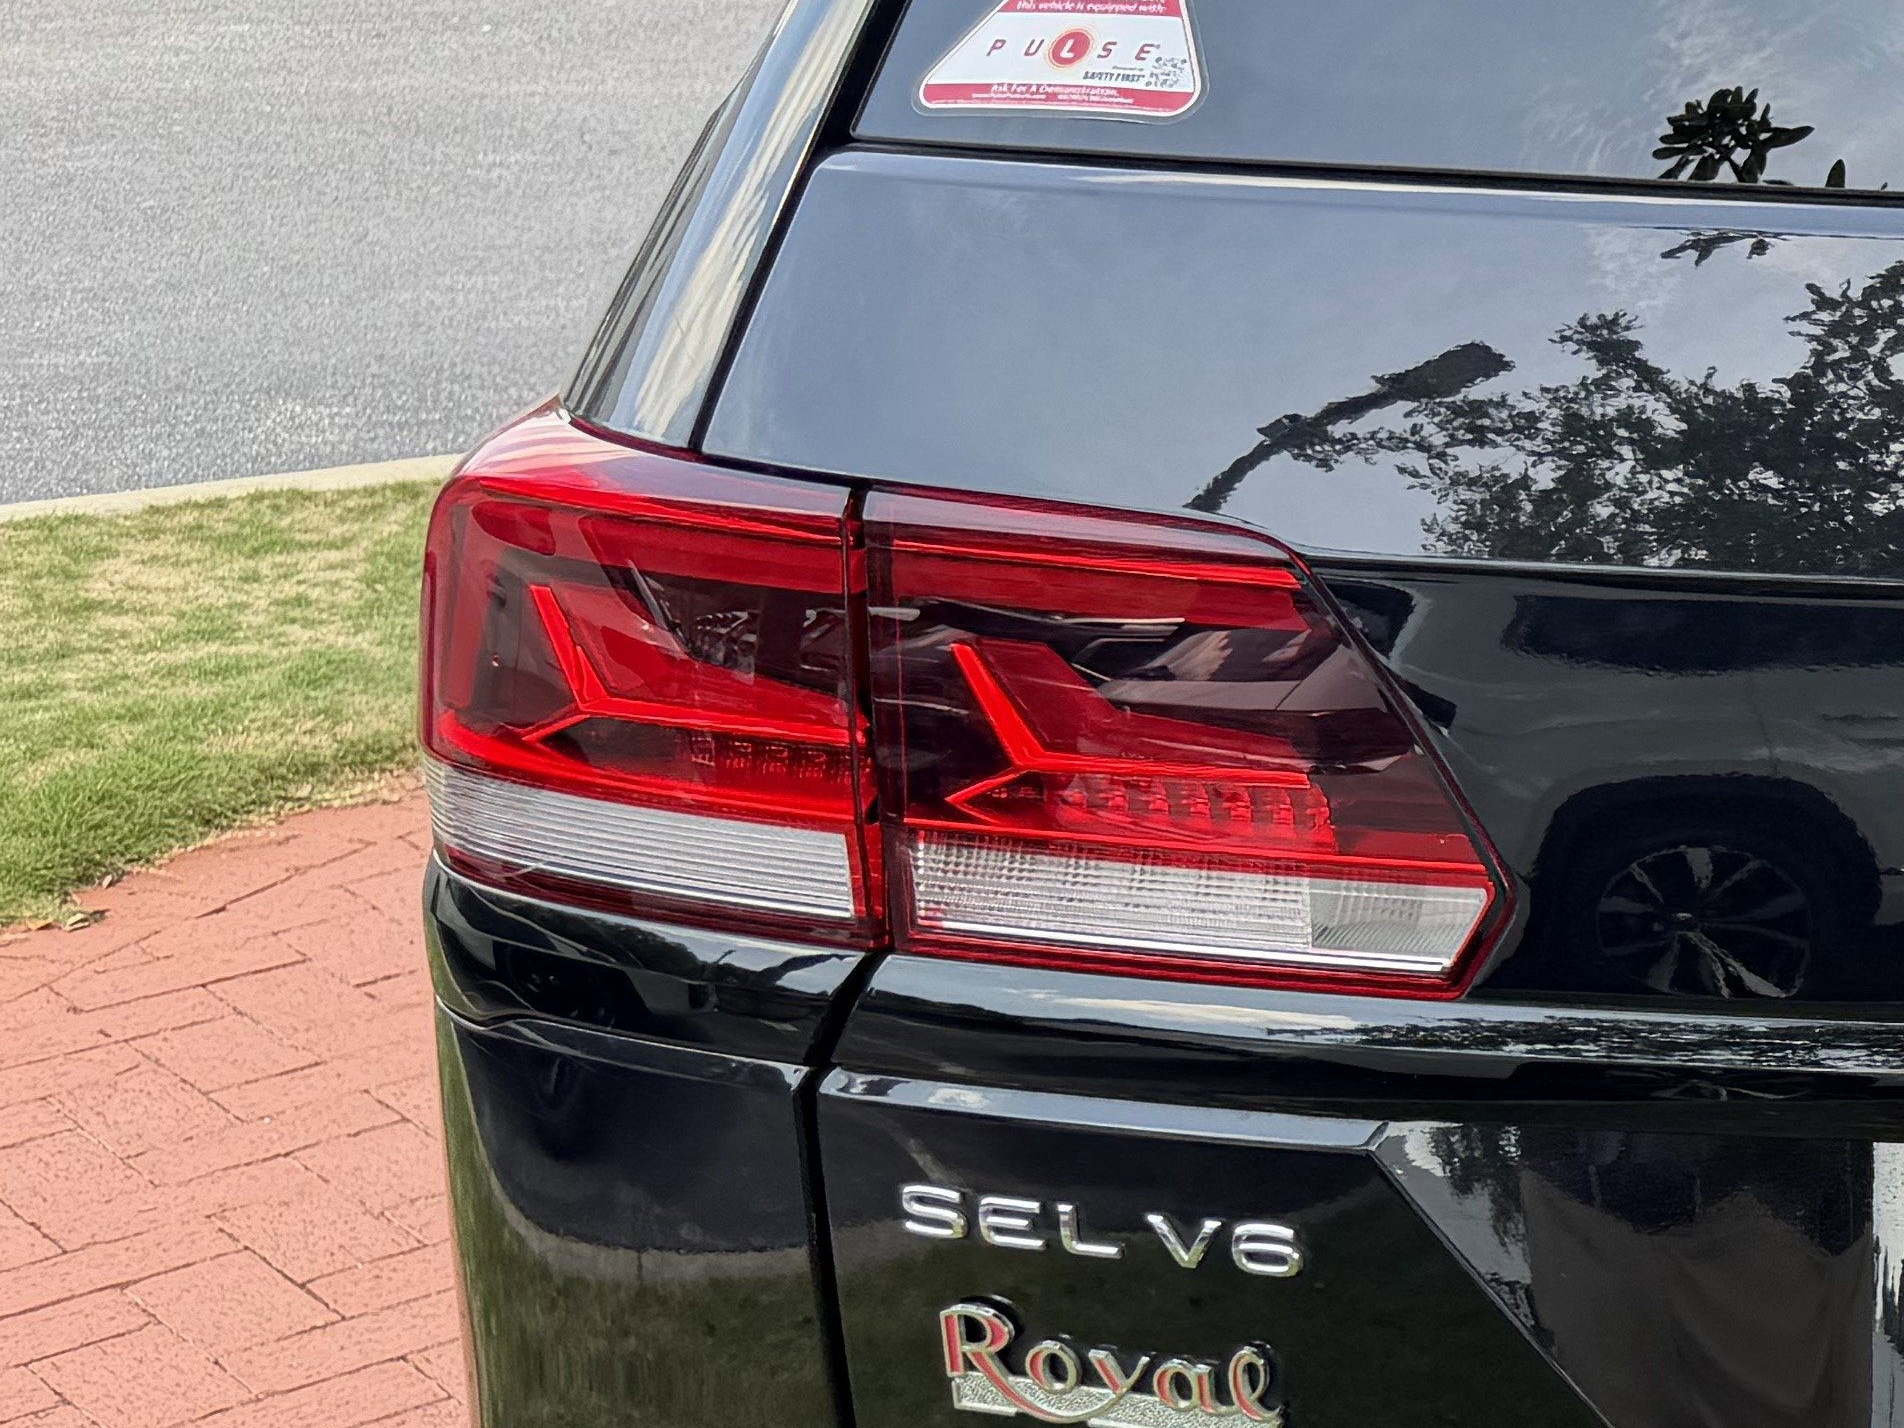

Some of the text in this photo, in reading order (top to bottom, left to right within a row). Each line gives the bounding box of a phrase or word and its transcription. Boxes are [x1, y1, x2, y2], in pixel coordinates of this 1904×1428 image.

[901, 1184, 1303, 1277] SEL V6
[940, 1303, 1284, 1424] Royal
